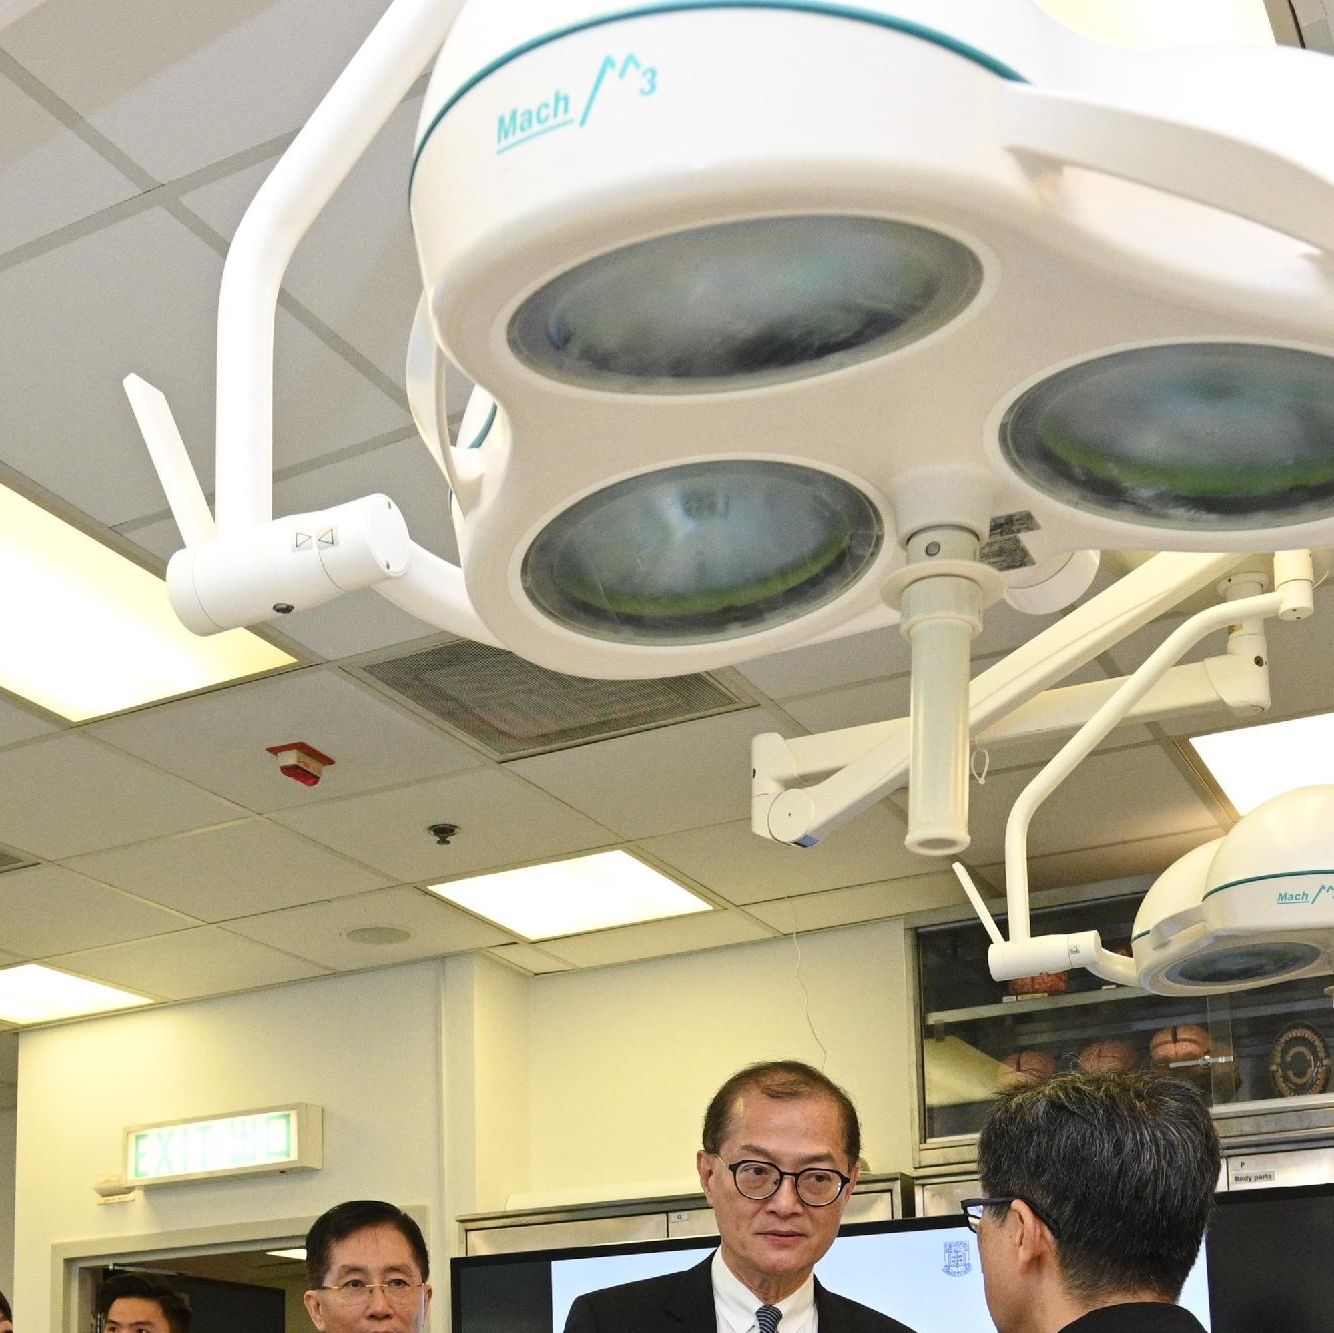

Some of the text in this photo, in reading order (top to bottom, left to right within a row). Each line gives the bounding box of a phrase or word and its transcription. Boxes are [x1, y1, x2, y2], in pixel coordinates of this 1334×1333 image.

[497, 89, 571, 145] Mach
[1277, 891, 1309, 902] Mach
[134, 1124, 212, 1178] EXIT
